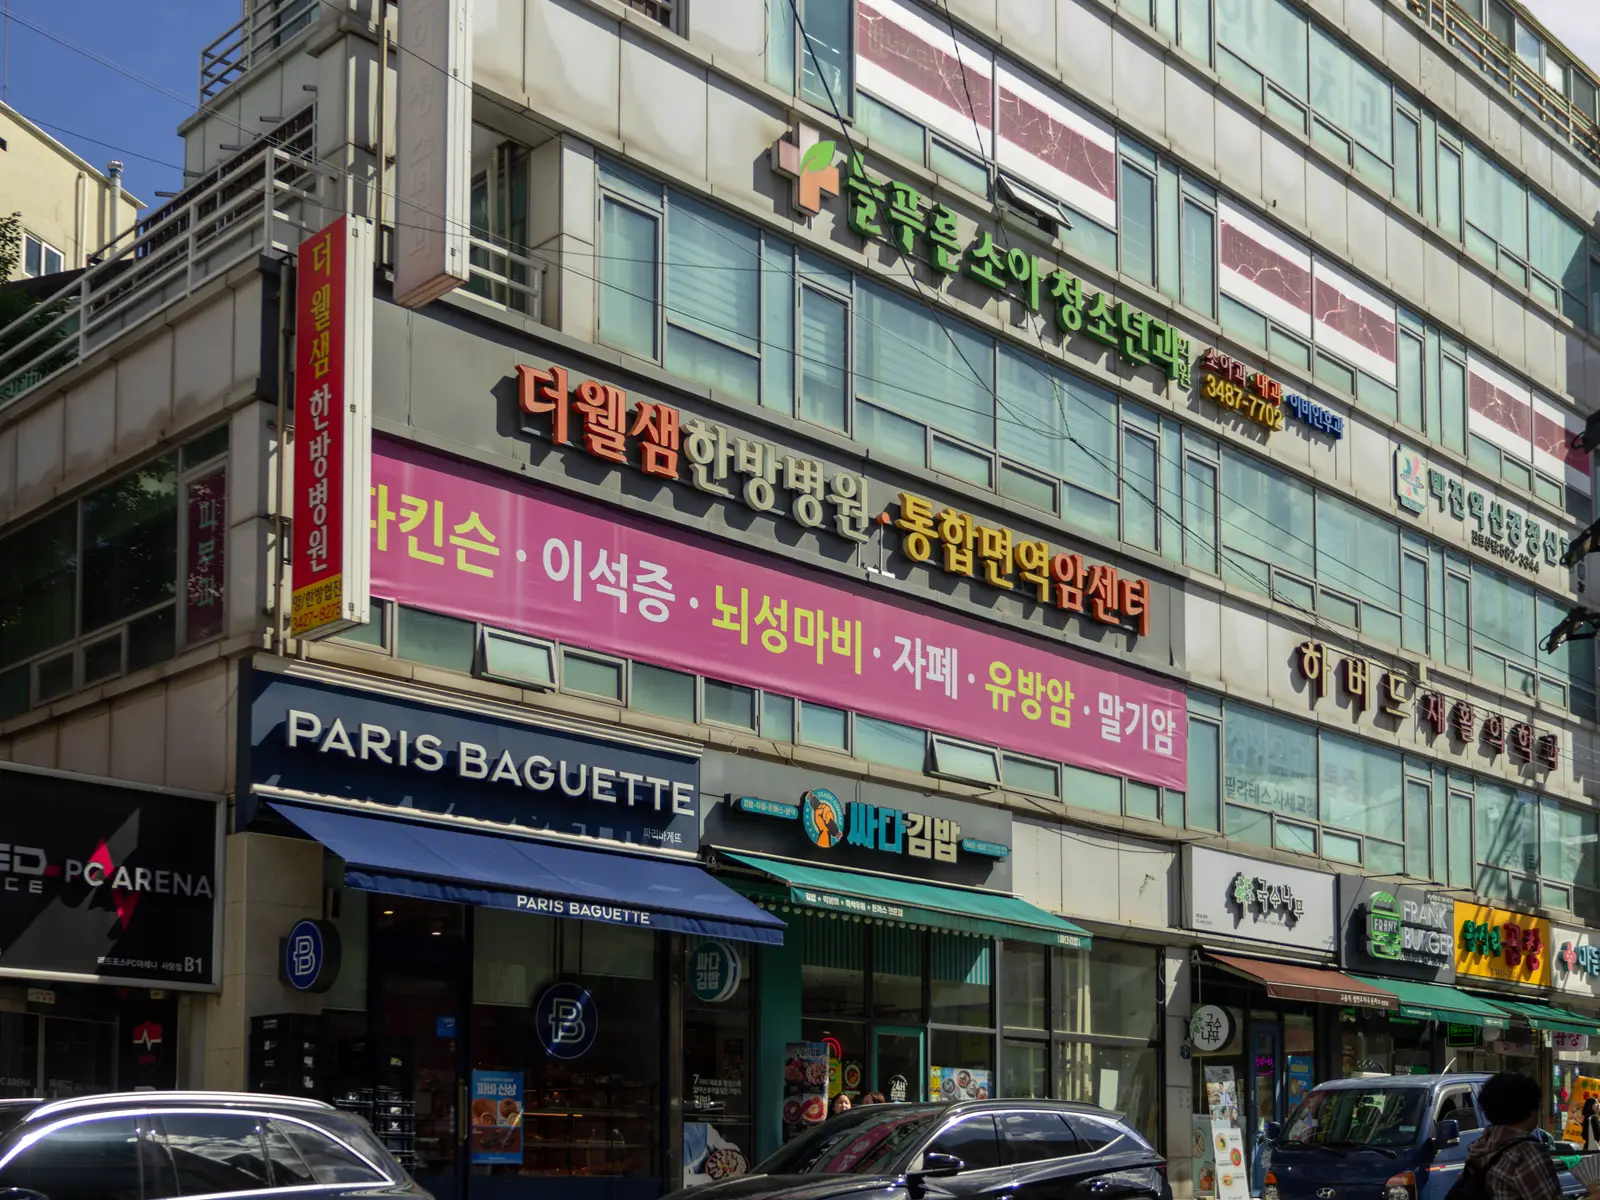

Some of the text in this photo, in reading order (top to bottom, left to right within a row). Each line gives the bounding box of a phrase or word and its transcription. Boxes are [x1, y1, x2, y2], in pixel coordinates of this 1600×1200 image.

[1204, 373, 1284, 432] 3487-7702
[543, 538, 676, 622] 이석증
[712, 584, 862, 675] 뇌성마비
[892, 636, 958, 699] 자폐
[985, 661, 1075, 728] 유방암
[1098, 692, 1176, 756] 말기암
[287, 709, 695, 816] PARIS BAGUETTE
[643, 827, 683, 844] 파리바게뜨
[65, 859, 105, 887] PC
[111, 865, 213, 898] ARENA
[1257, 877, 1304, 920] 국수나무
[516, 894, 651, 925] PARIS BAGUETTE
[1403, 899, 1447, 930] FRANK
[1374, 918, 1397, 933] FRANK
[1404, 926, 1454, 957] BURGER
[184, 956, 203, 974] B1
[696, 951, 722, 971] 싸다
[696, 971, 721, 991] 김밥
[1204, 1013, 1223, 1031] 국수
[1201, 1030, 1221, 1045] 나무
[498, 1082, 517, 1097] 신상
[890, 1079, 907, 1093] 24H
